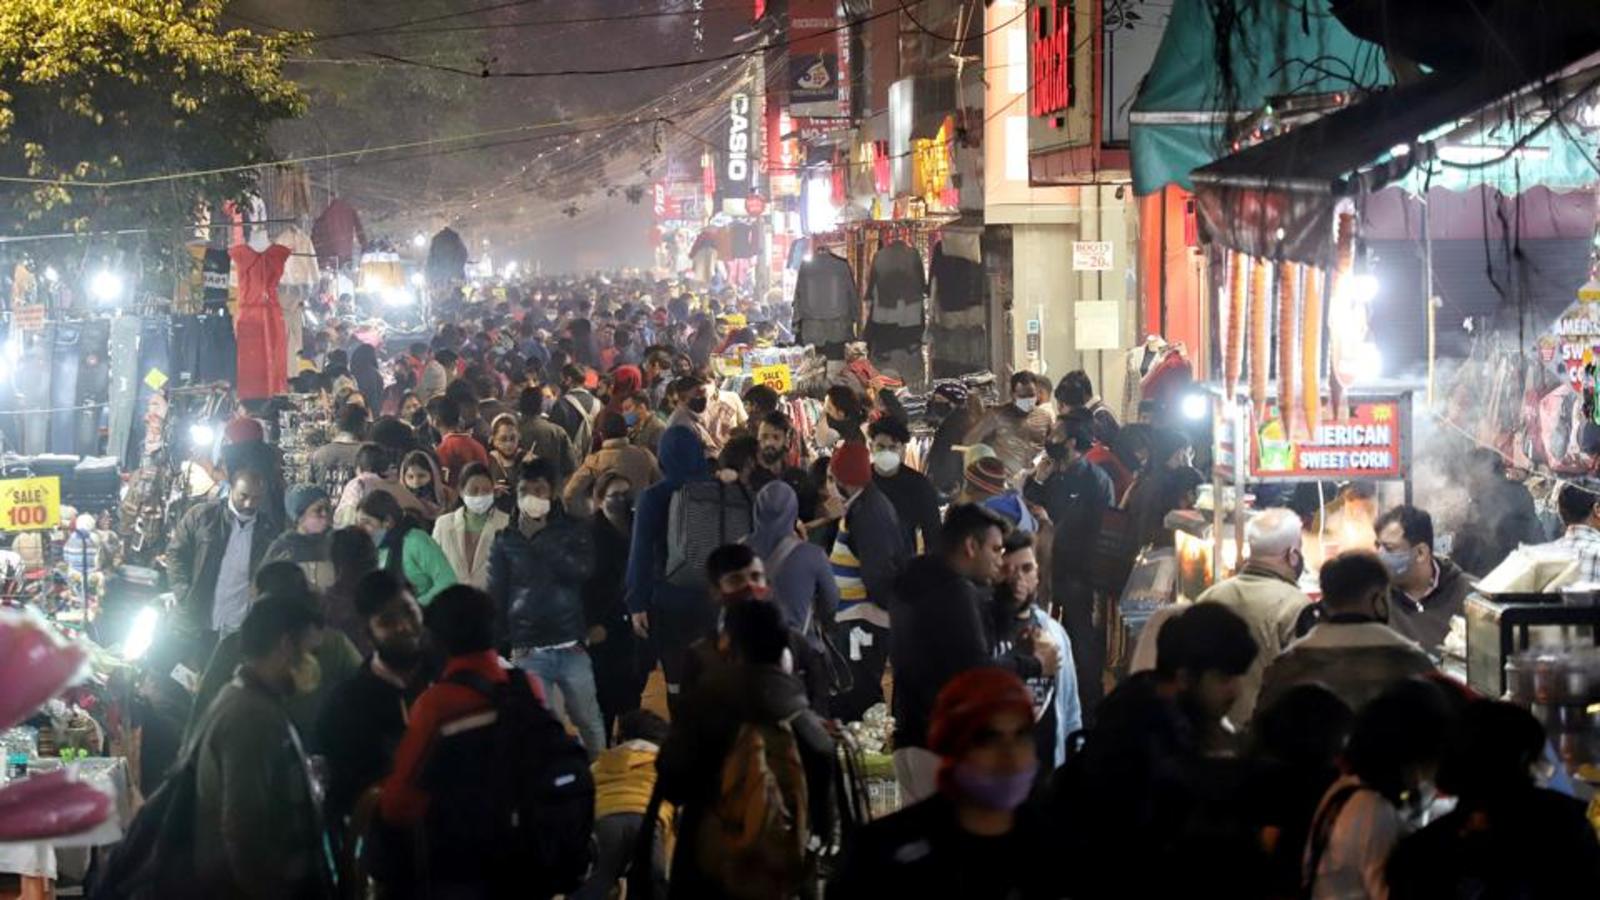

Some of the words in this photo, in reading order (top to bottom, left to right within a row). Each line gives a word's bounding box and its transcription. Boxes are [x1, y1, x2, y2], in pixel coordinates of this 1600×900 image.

[728, 92, 749, 181] CASIO
[1299, 451, 1347, 470] SWEET
[1350, 451, 1391, 470] CORN
[13, 489, 42, 505] SALE
[7, 505, 48, 527] 100
